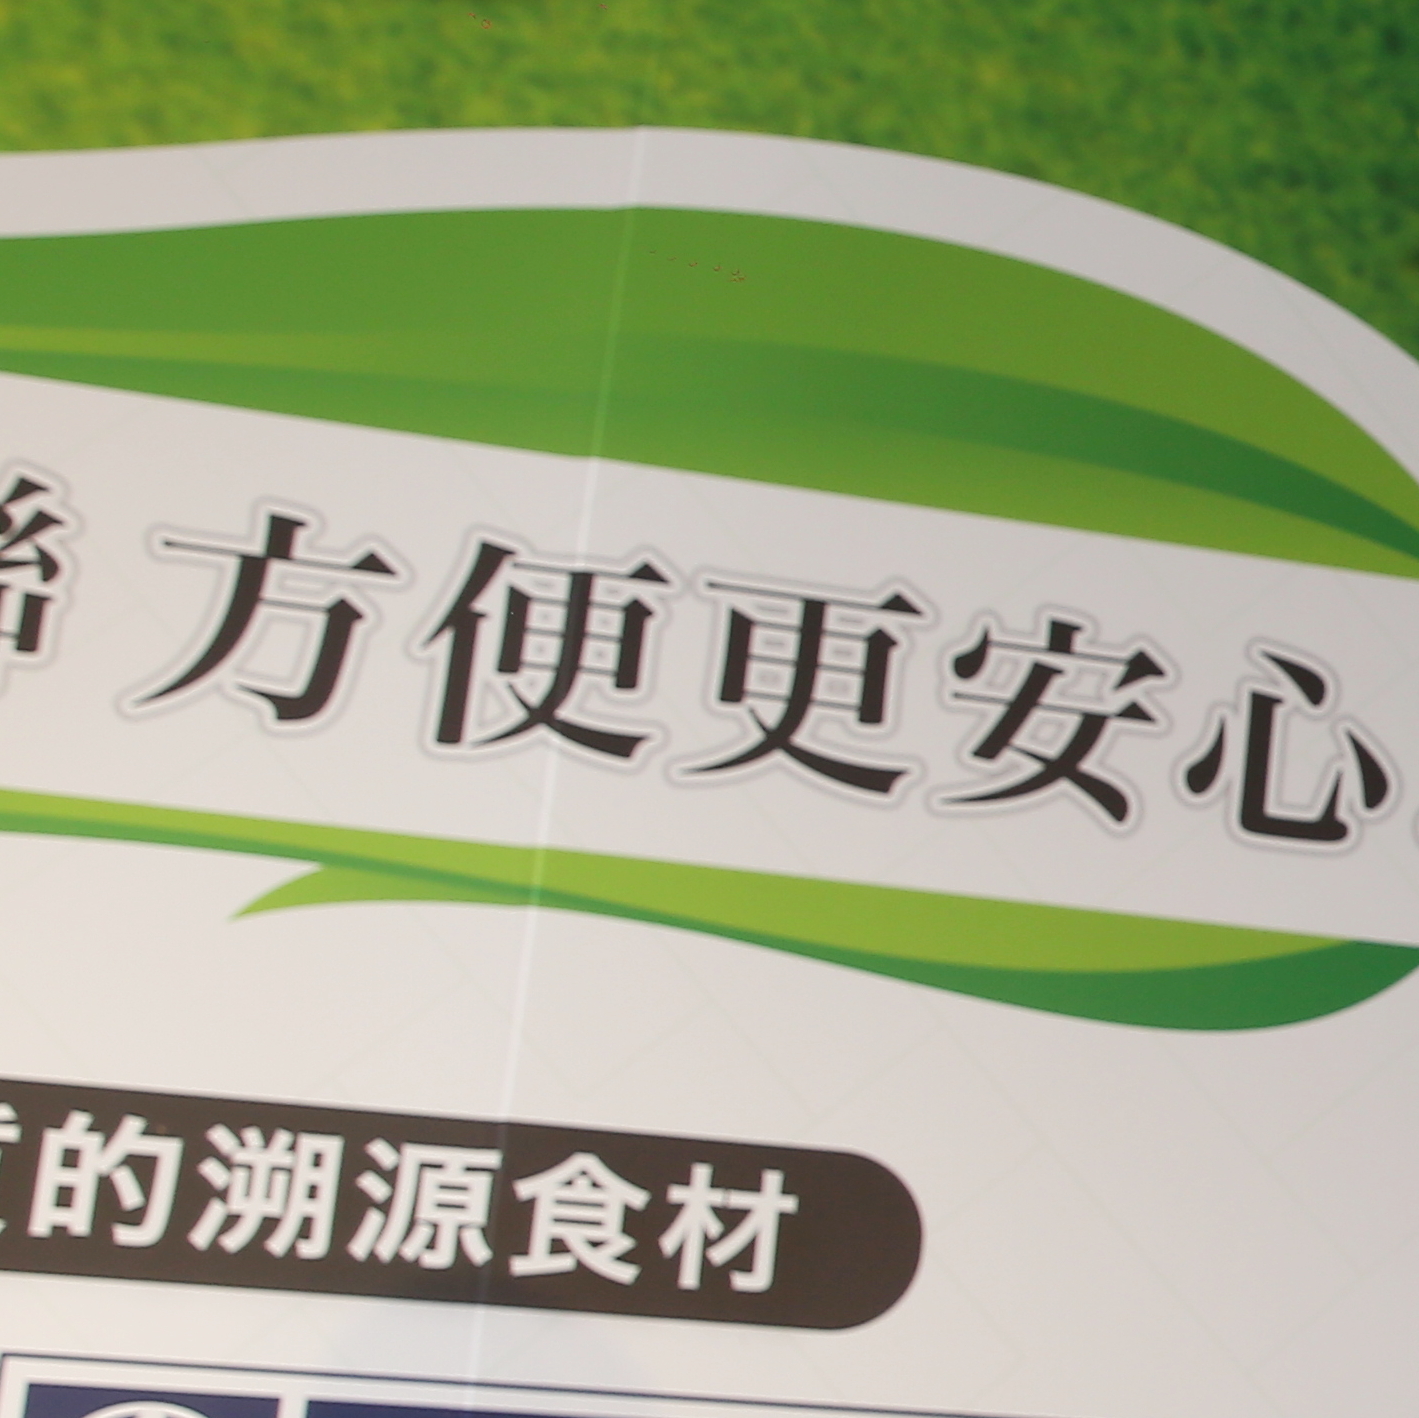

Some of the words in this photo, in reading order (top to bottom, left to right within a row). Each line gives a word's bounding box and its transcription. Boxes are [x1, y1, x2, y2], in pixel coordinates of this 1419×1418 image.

[0, 1102, 799, 1293] 的溯源食材
